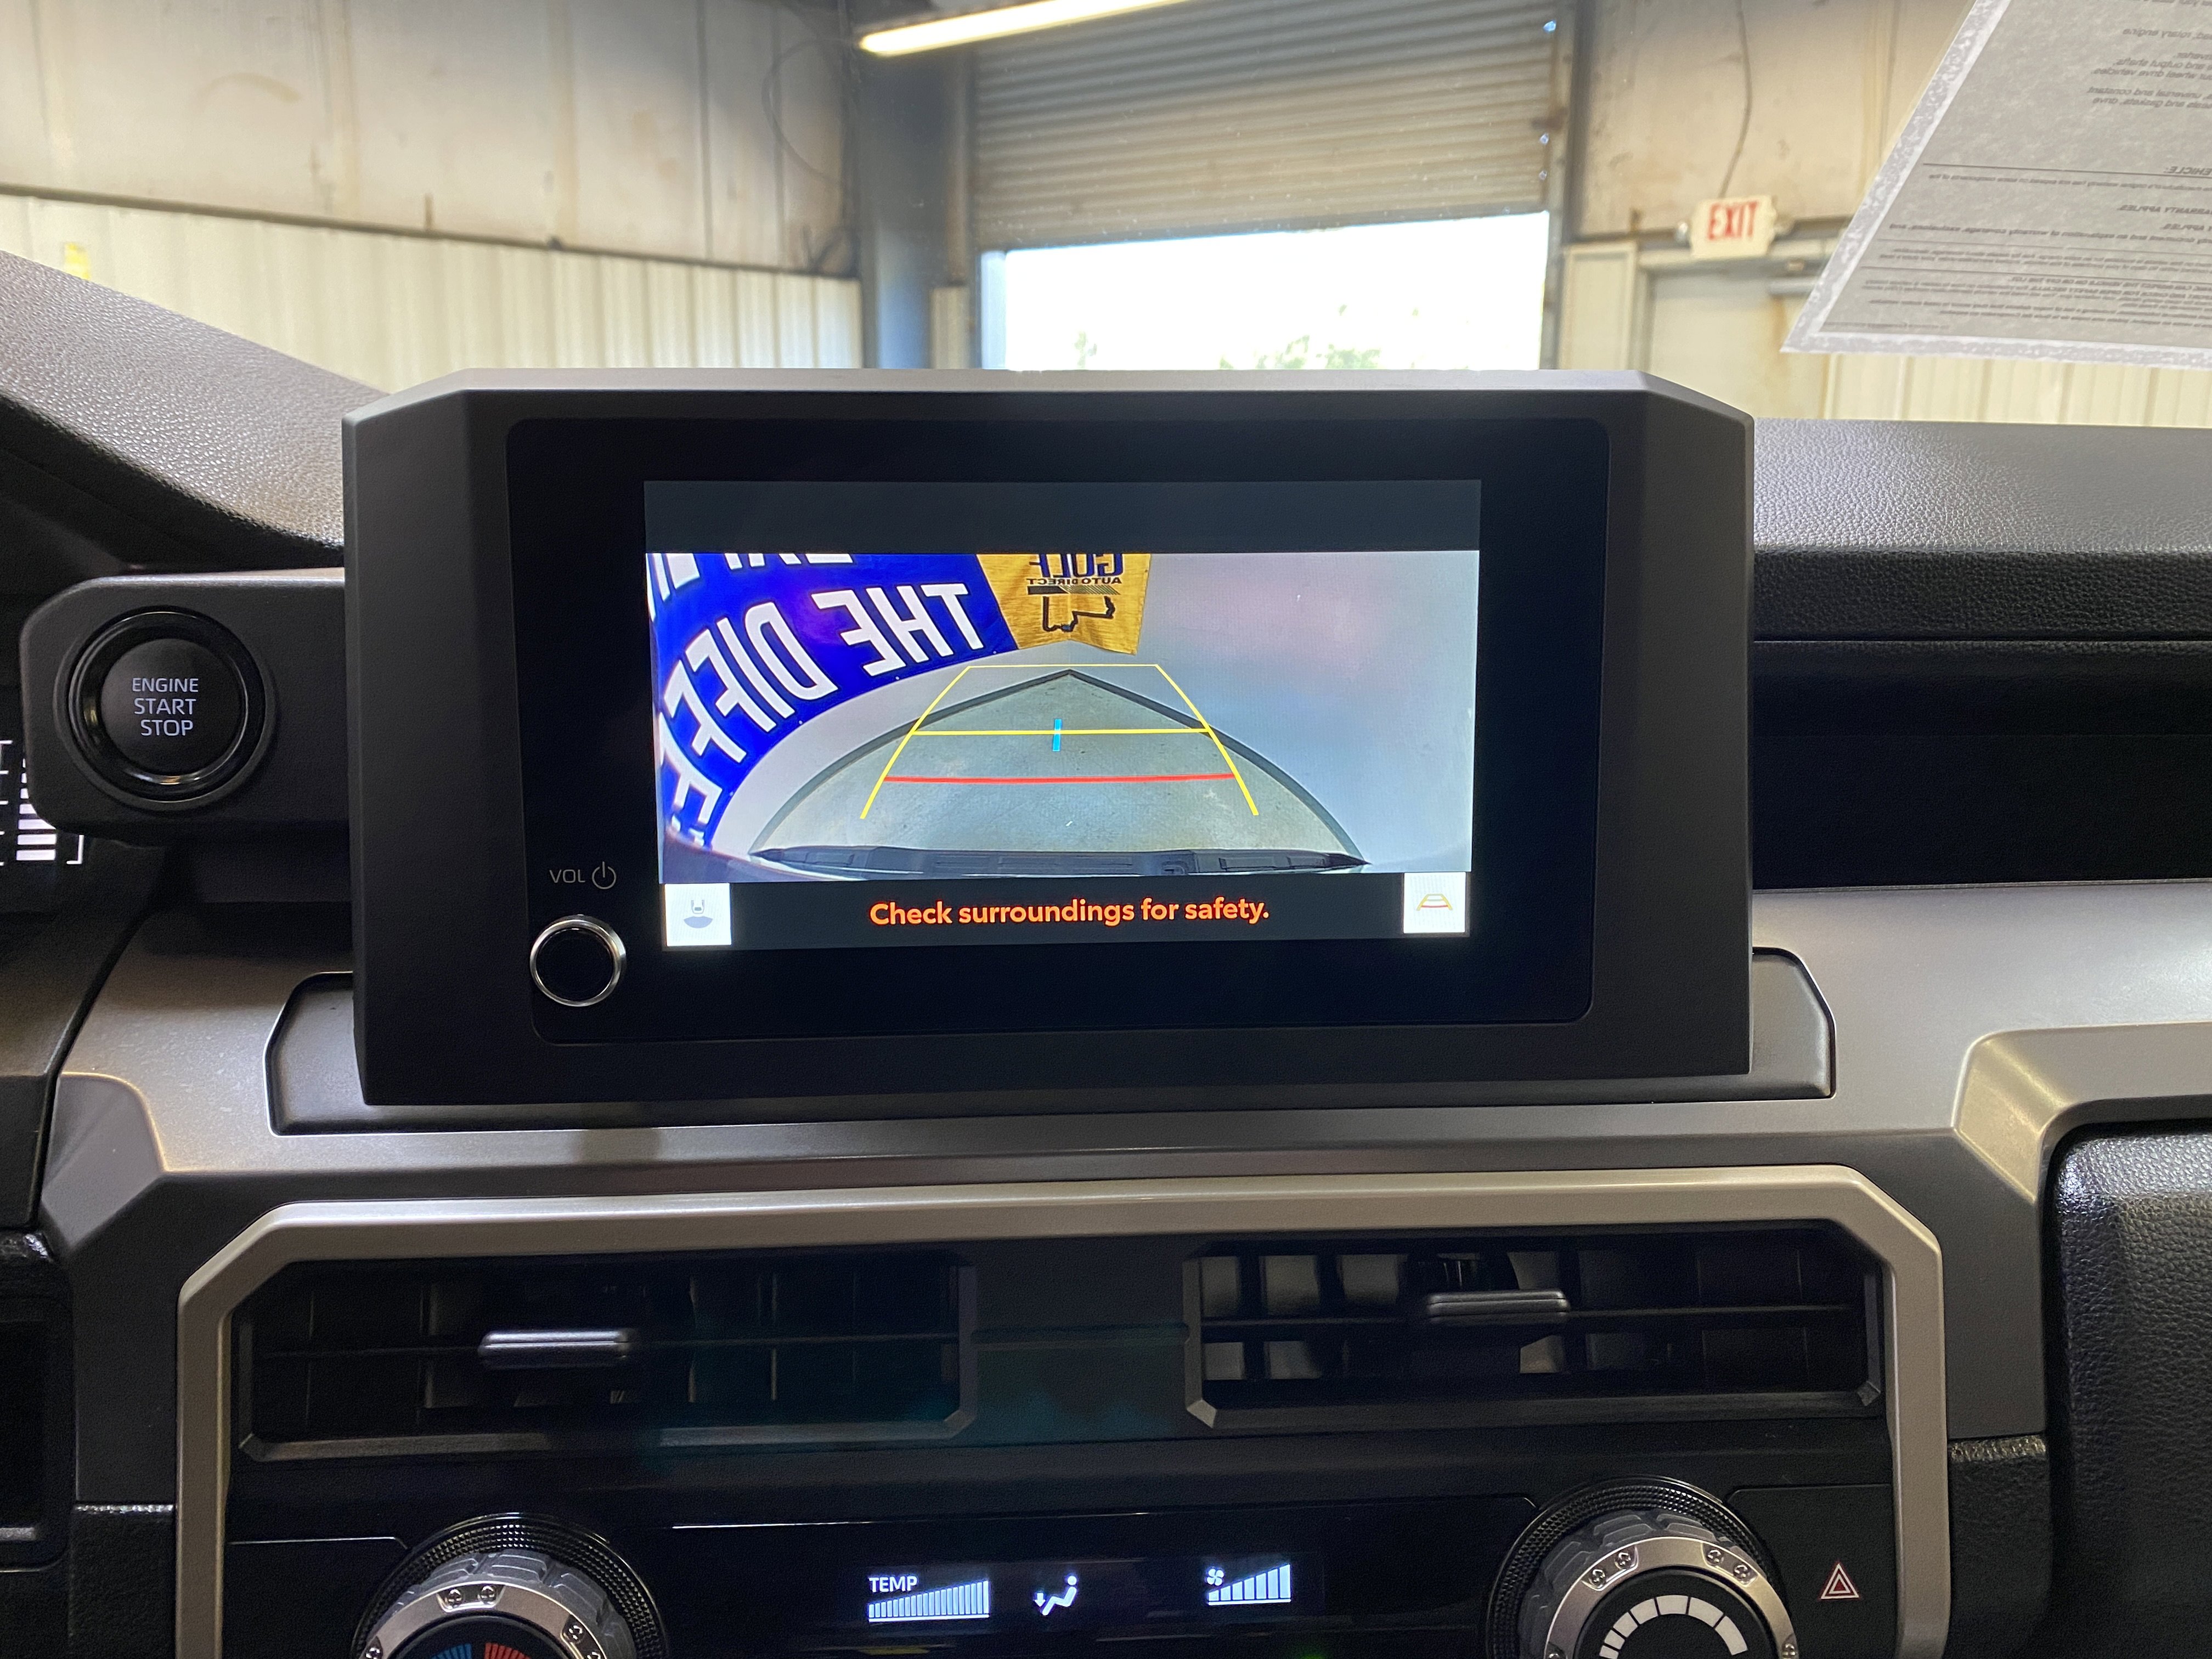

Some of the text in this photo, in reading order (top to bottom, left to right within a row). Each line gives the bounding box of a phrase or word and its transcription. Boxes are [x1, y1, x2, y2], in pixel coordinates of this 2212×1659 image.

[1707, 201, 1759, 240] EXIT
[132, 678, 199, 692] ENGINE
[134, 698, 196, 715] START
[140, 720, 194, 736] STOP
[550, 869, 586, 883] VOL
[870, 895, 1269, 928] Check surroundings for safety.
[868, 1575, 918, 1593] TEMP
